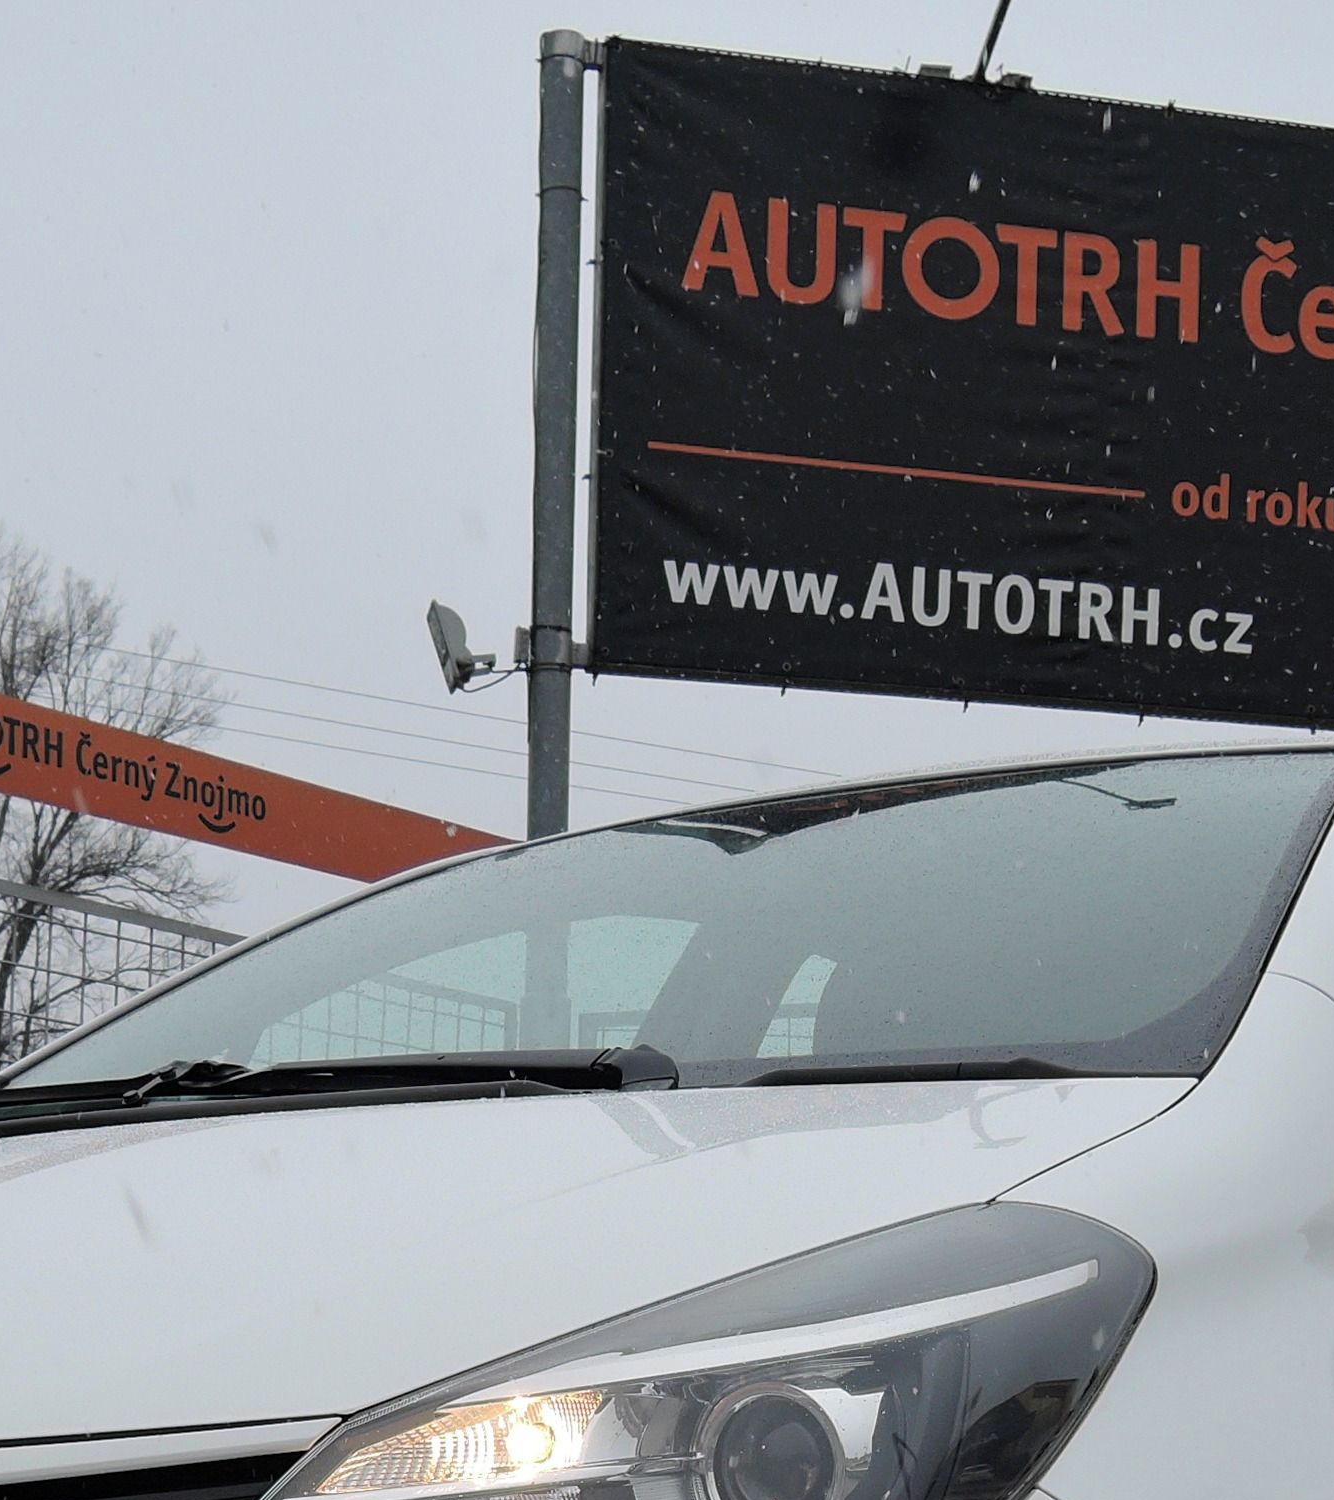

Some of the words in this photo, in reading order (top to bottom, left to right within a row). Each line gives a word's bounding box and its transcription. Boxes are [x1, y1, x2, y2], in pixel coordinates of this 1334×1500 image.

[680, 190, 1200, 344] AUTOTRH
[1172, 473, 1230, 521] od
[662, 558, 1255, 656] www.AUTOTRH.cz
[75, 731, 157, 801] Černý
[164, 762, 266, 821] Znojmo
